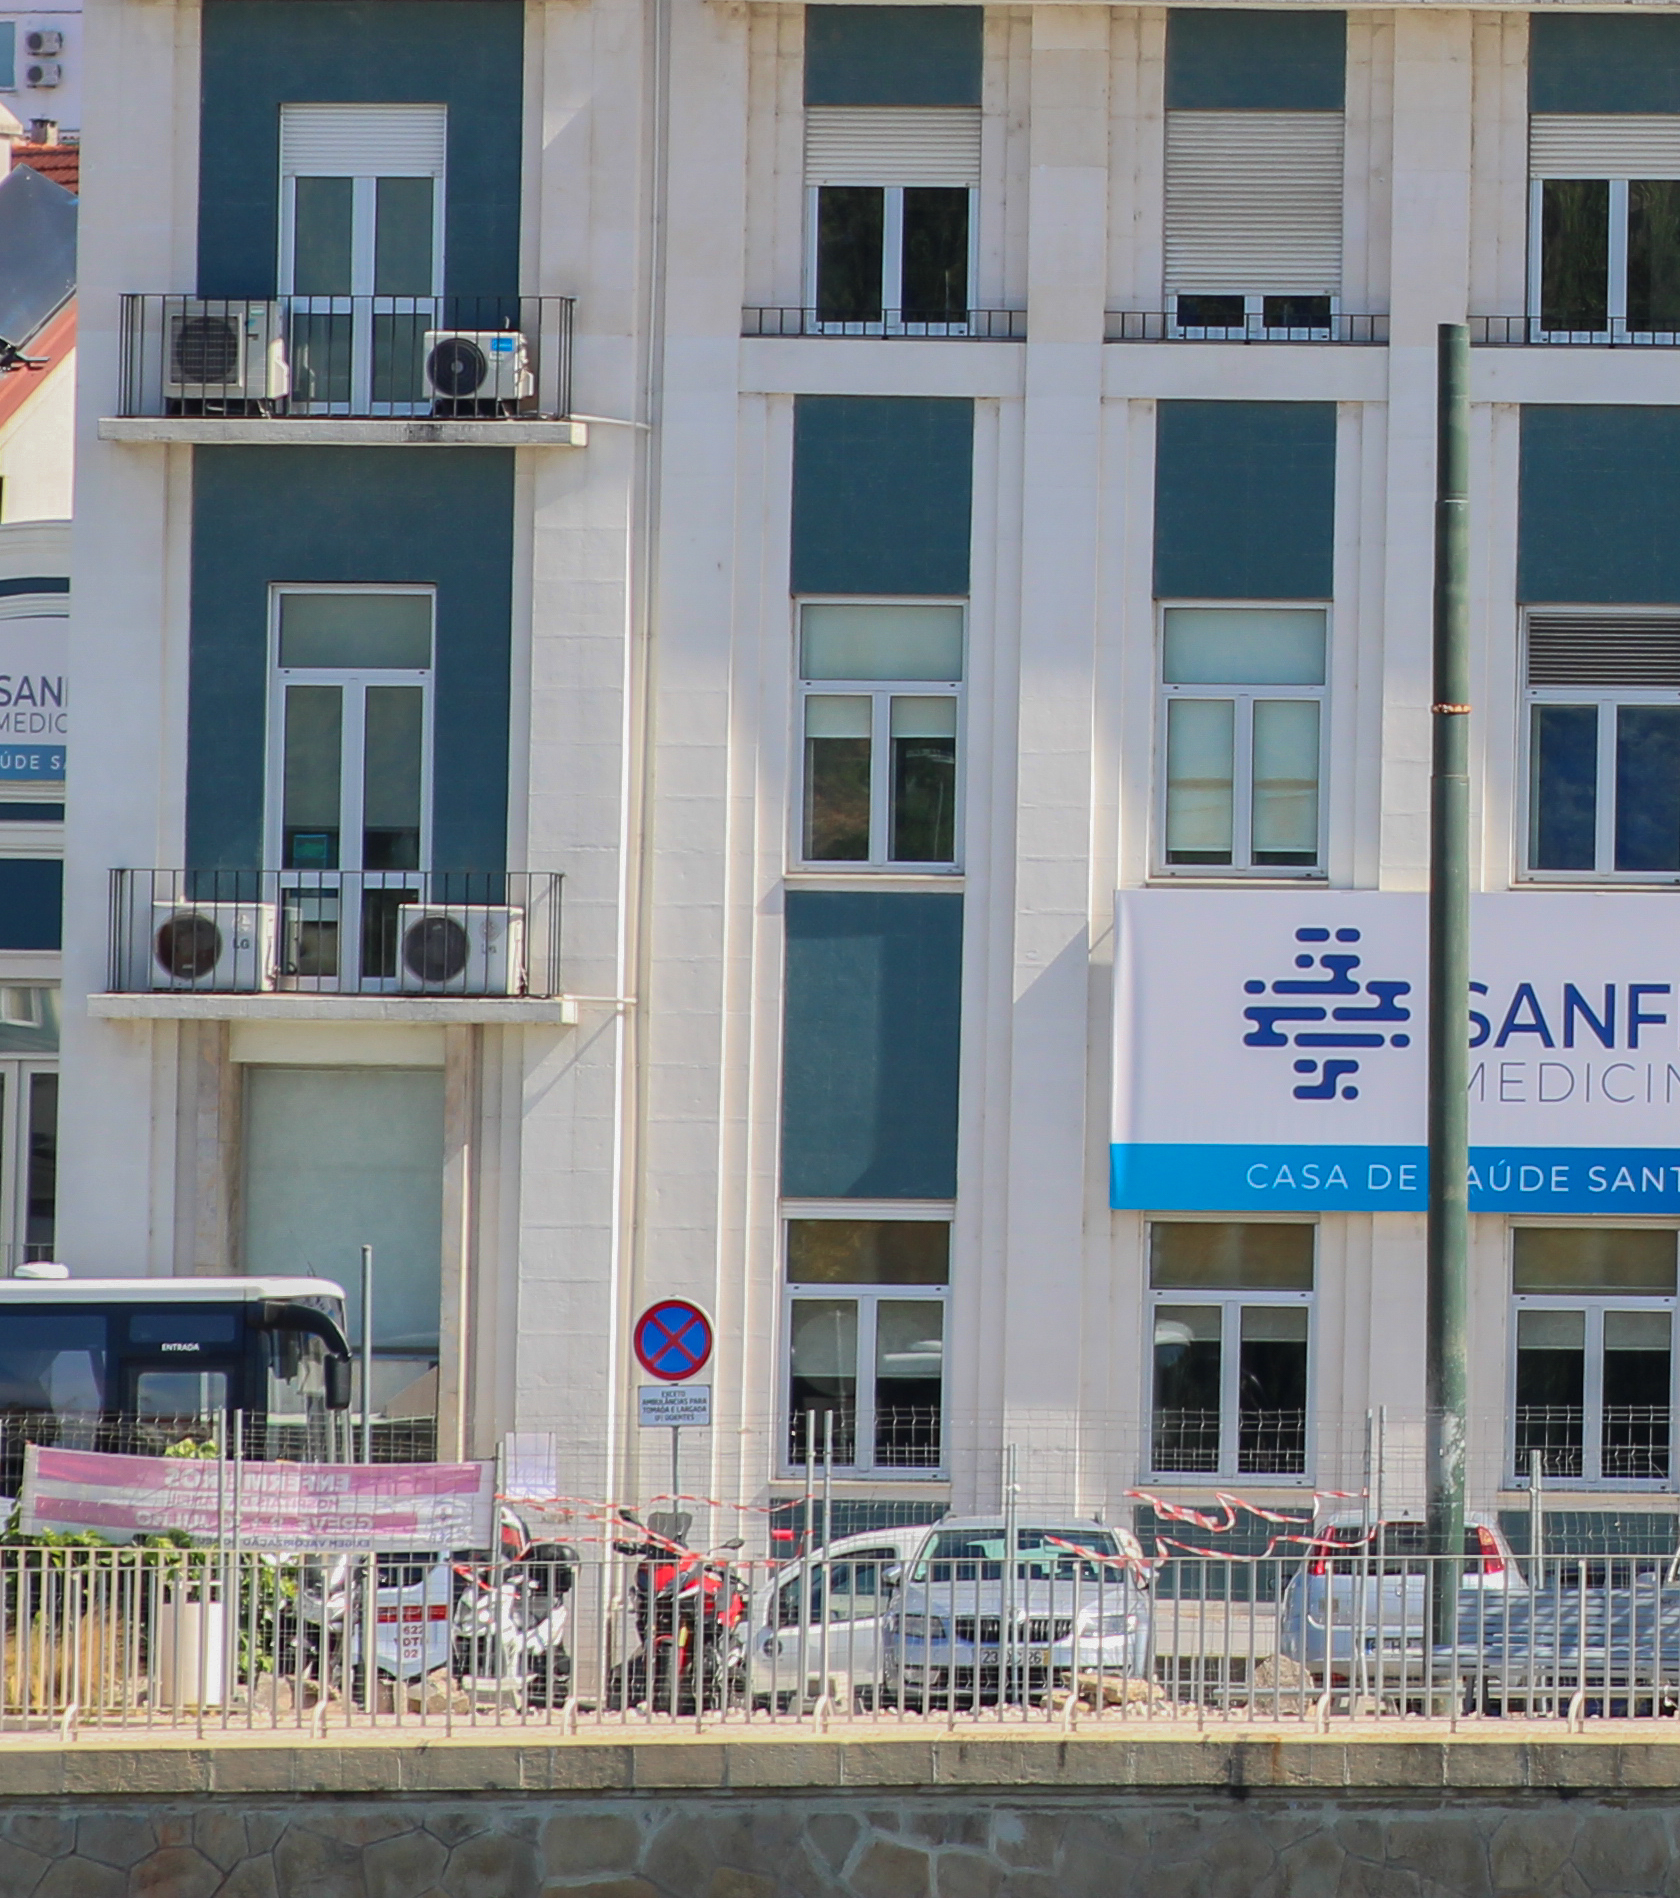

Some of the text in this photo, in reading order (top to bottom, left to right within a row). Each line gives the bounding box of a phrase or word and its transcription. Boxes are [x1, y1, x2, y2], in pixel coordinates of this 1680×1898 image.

[0, 675, 67, 708] SAN
[50, 755, 66, 770] S
[233, 938, 250, 949] LG
[1246, 1163, 1349, 1190] CASA
[1368, 1164, 1418, 1190] DE
[1466, 1159, 1570, 1192] AÚDE
[161, 1342, 200, 1352] ENTRADA
[661, 1390, 686, 1398] EXCETO
